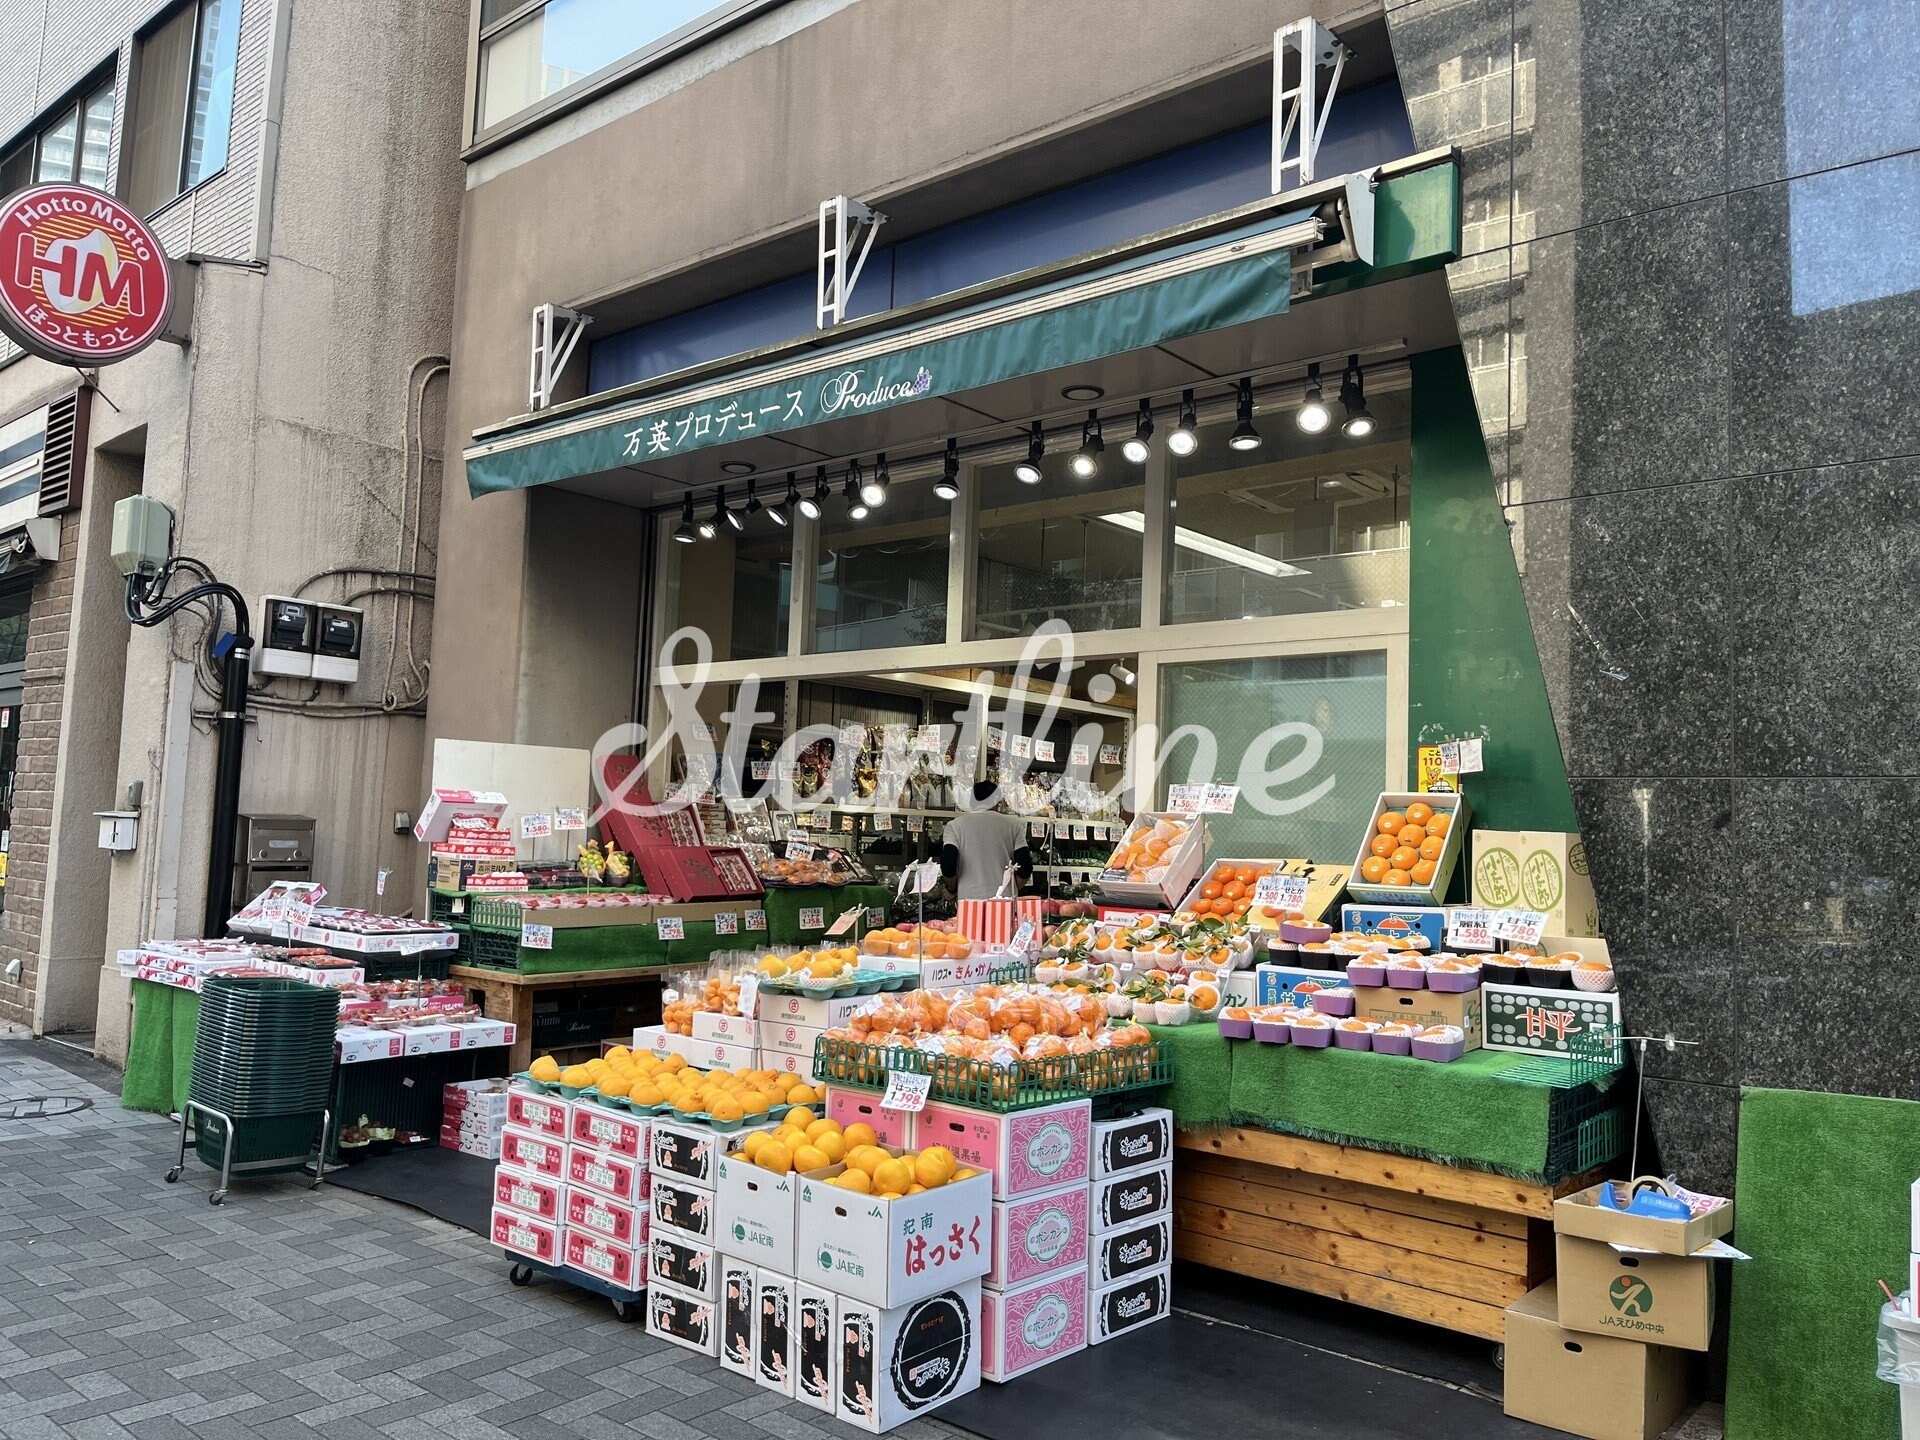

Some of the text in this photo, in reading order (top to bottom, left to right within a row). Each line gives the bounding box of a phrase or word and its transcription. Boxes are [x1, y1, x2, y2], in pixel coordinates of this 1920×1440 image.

[15, 196, 150, 261] Hotto Motto
[15, 232, 145, 317] HM
[24, 303, 134, 347] ほっともっと
[820, 369, 913, 414] Produce
[622, 390, 804, 457] 万英プロデュース
[1423, 757, 1442, 766] 110
[1515, 1006, 1582, 1041] 甘平
[896, 1083, 925, 1095] はっさく
[748, 1230, 774, 1249] JA紀南
[903, 1212, 933, 1236] 紀南
[906, 1215, 981, 1277] はっさく
[835, 1258, 864, 1278] JA紀南
[1599, 1316, 1665, 1335] JAえひめ中央
